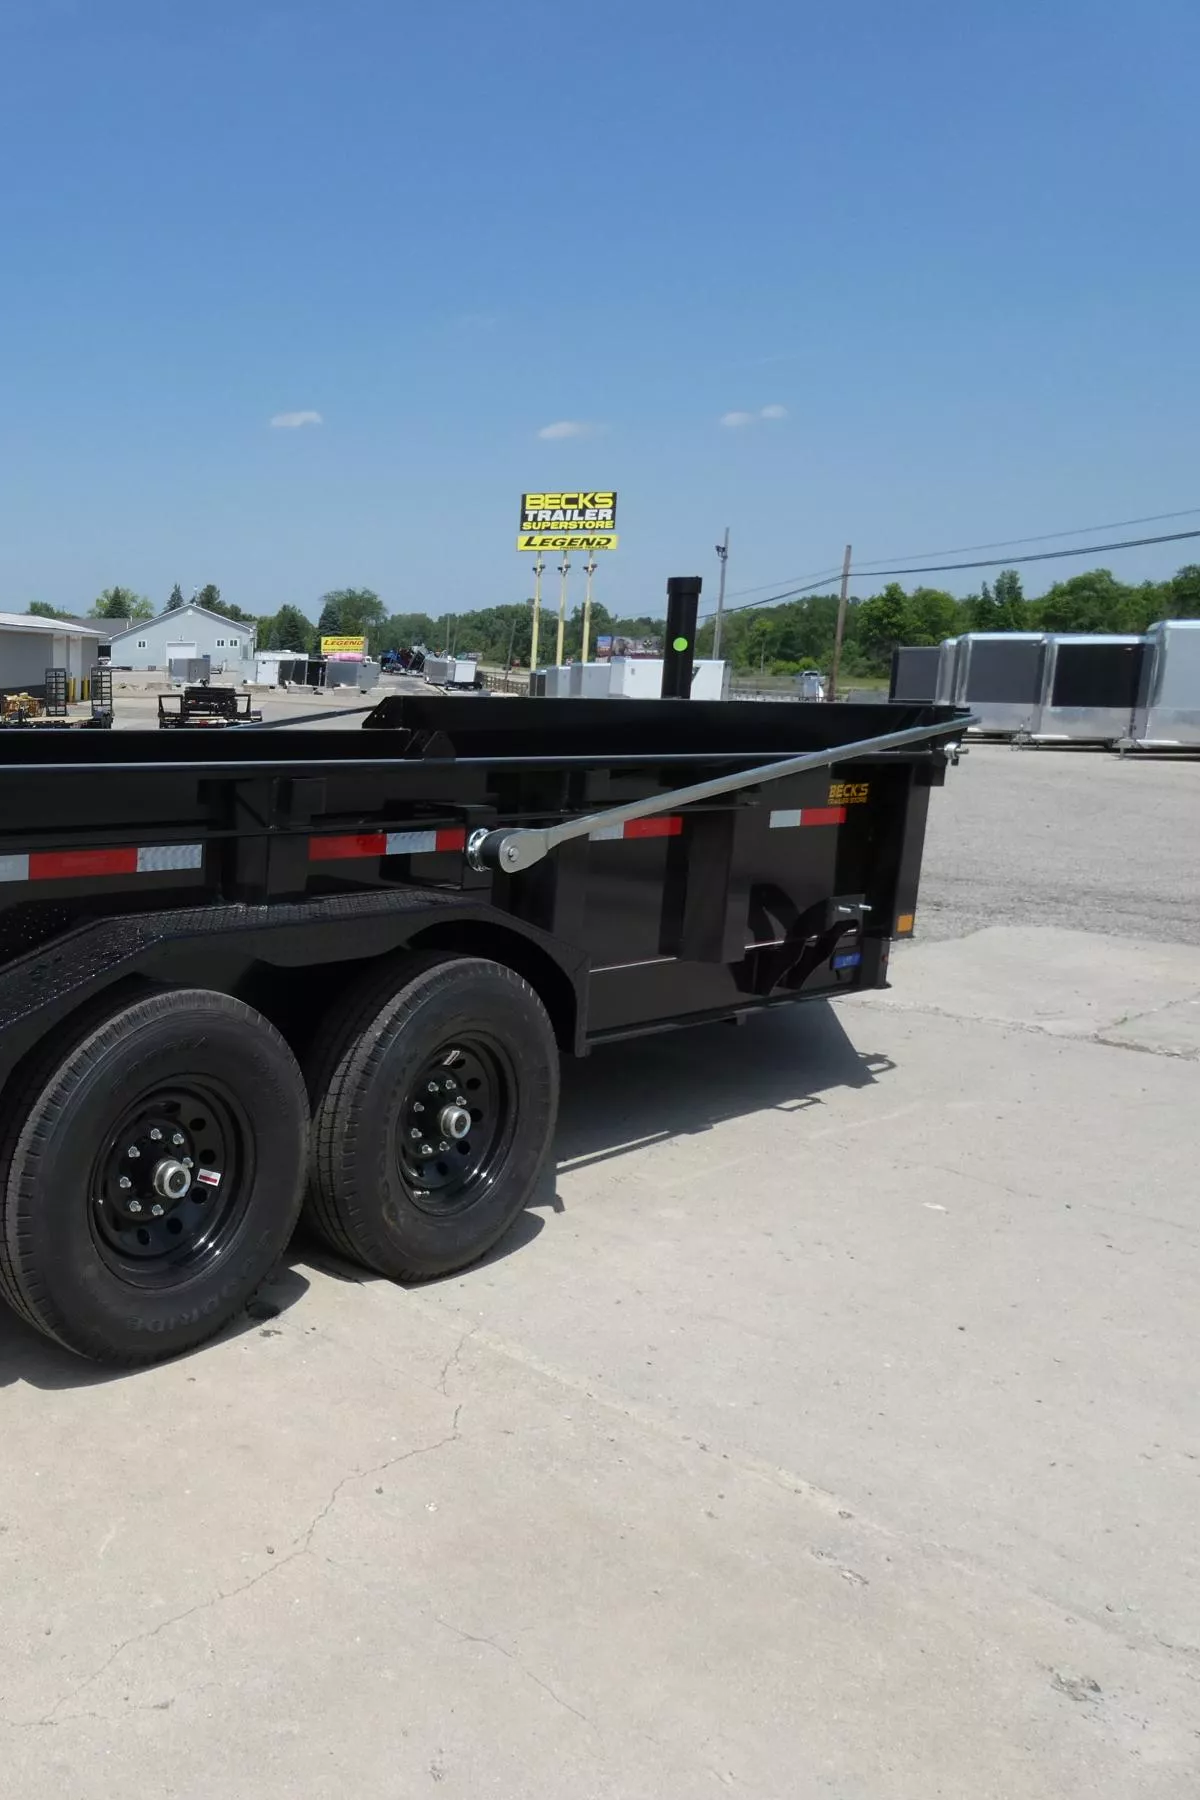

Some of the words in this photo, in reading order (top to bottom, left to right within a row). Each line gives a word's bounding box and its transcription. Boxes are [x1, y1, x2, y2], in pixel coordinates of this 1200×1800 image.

[525, 493, 613, 510] BECKS
[525, 509, 613, 521] TRAILER
[522, 521, 614, 530] SUPERSTORE
